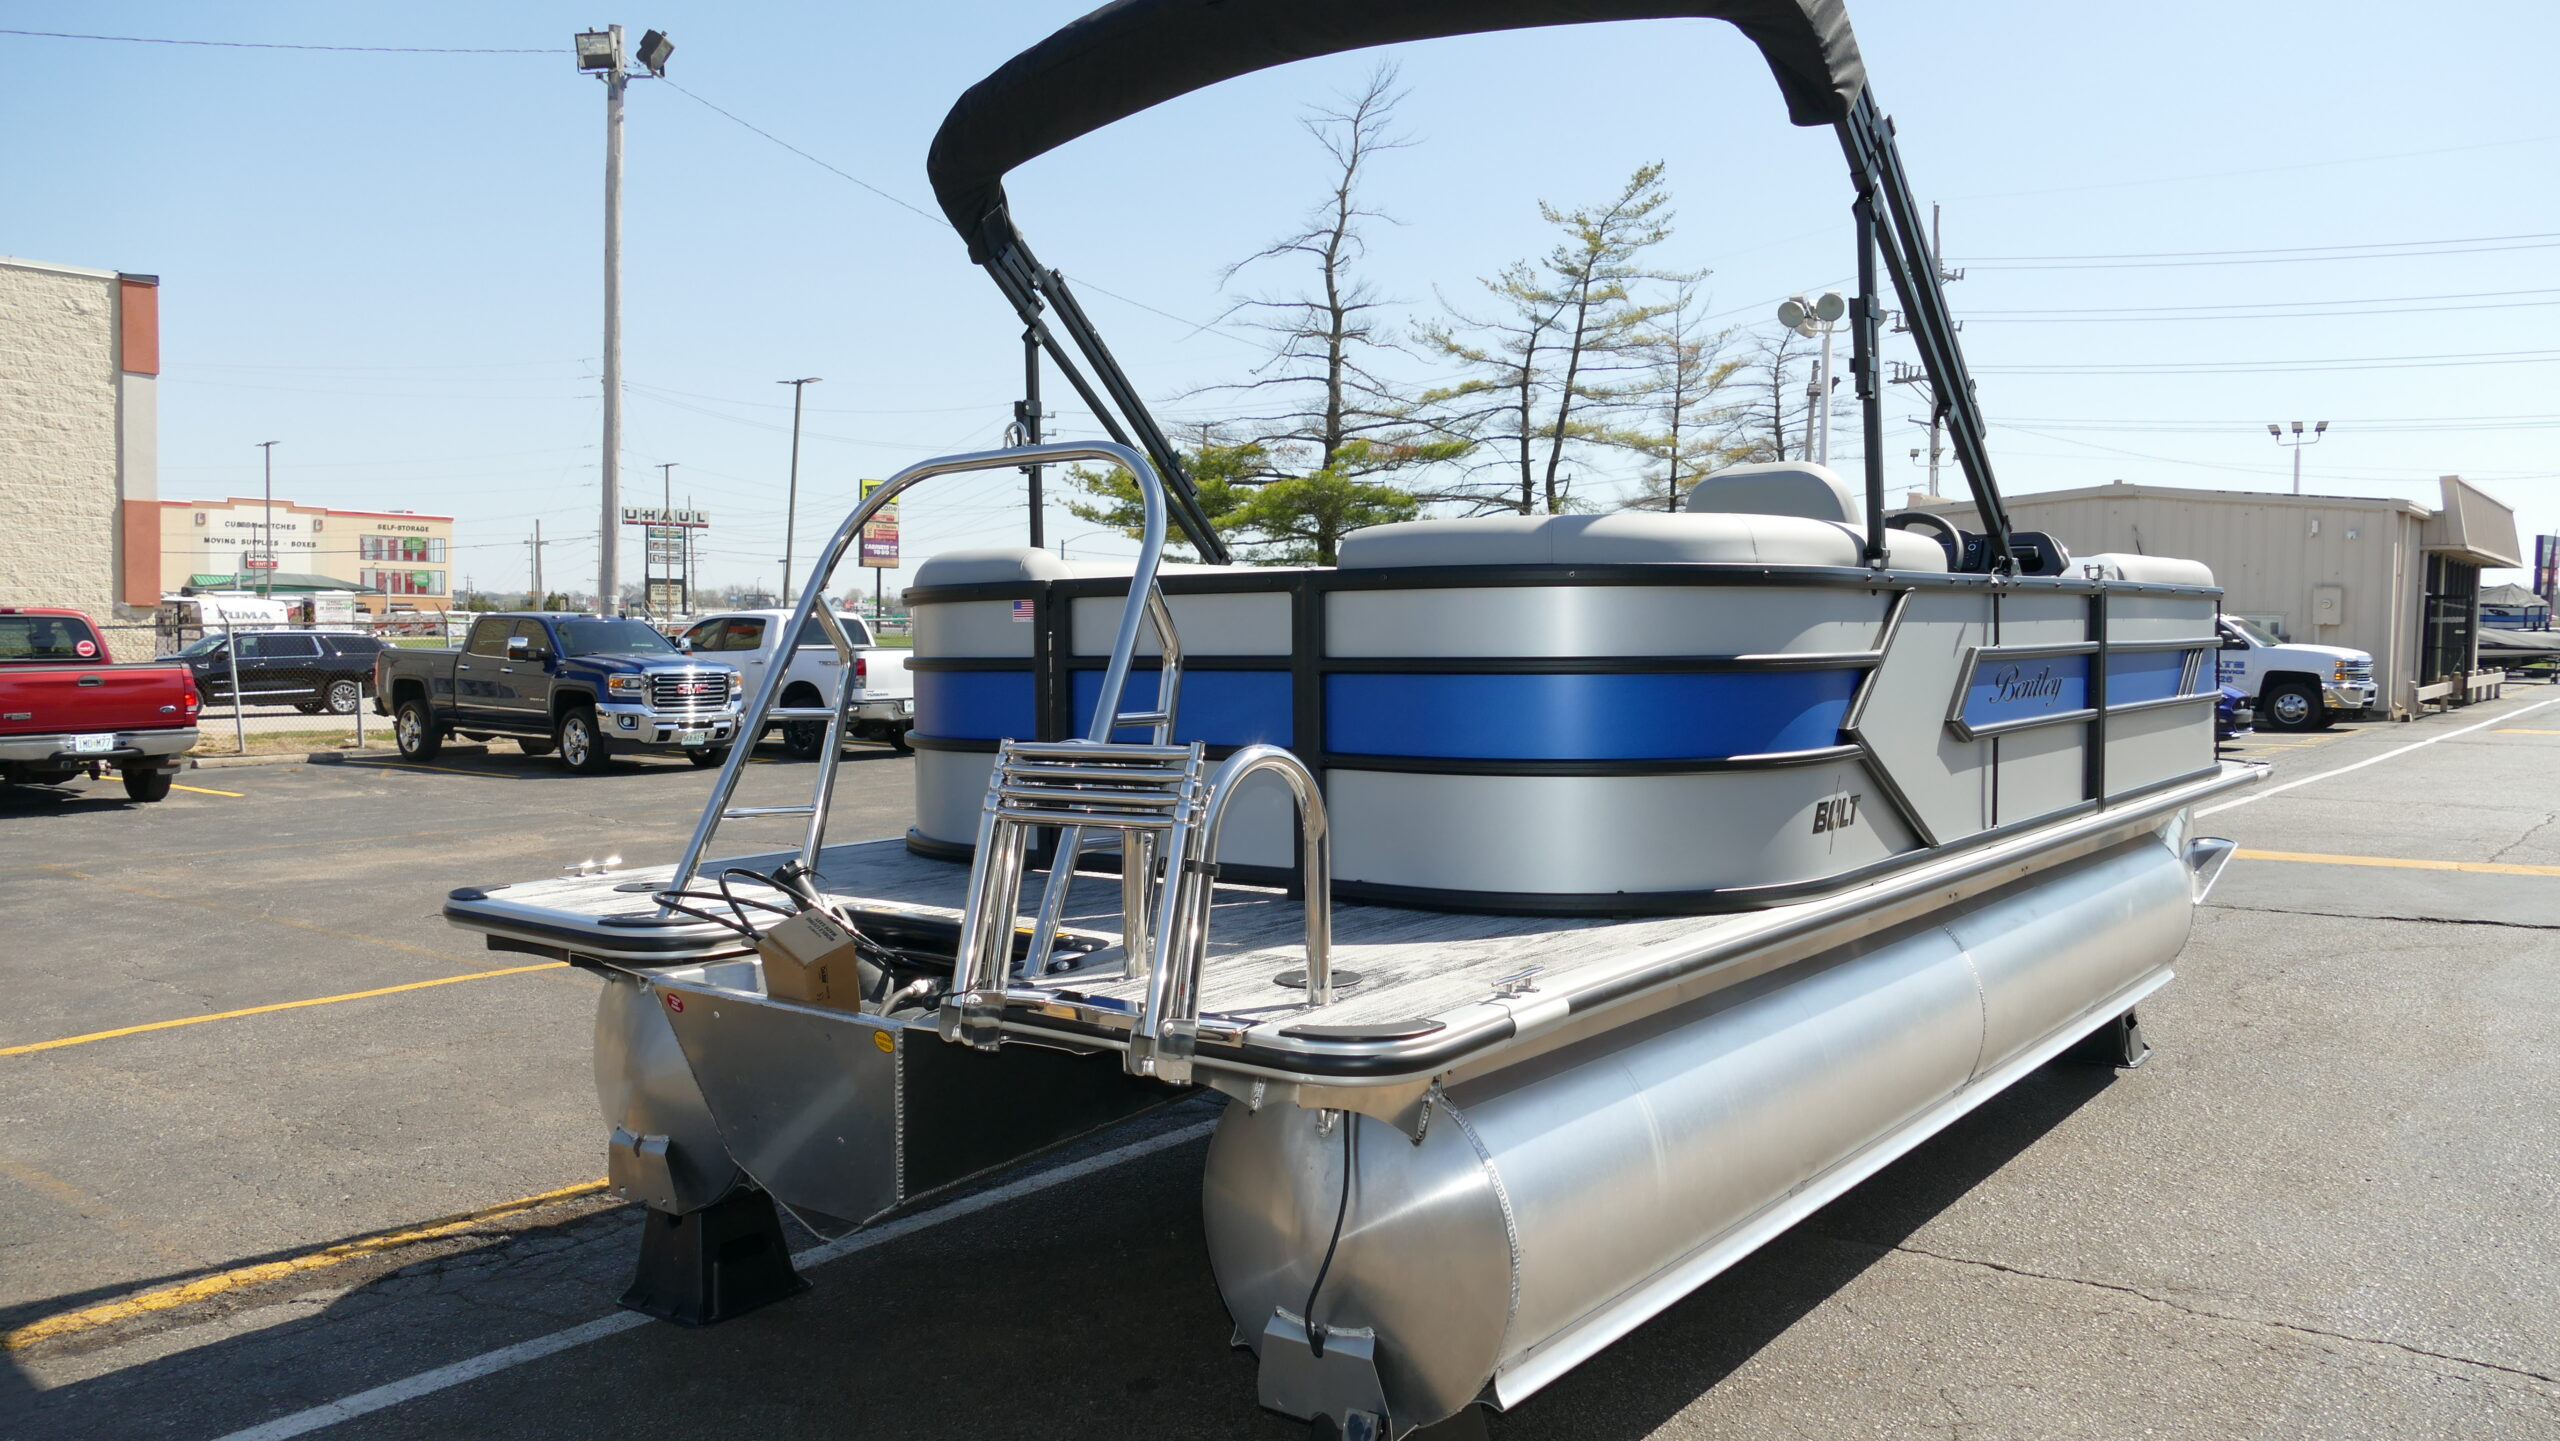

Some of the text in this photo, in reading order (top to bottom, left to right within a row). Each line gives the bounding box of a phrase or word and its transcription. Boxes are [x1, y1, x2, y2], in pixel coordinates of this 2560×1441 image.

[377, 523, 430, 533] SELF-STORAGE
[203, 536, 317, 549] MOVING SUPPLES BOXES
[217, 609, 271, 620] PUMA
[675, 683, 709, 695] GMC
[1988, 663, 2064, 708] Bentley
[1812, 793, 1862, 836] BOLT
